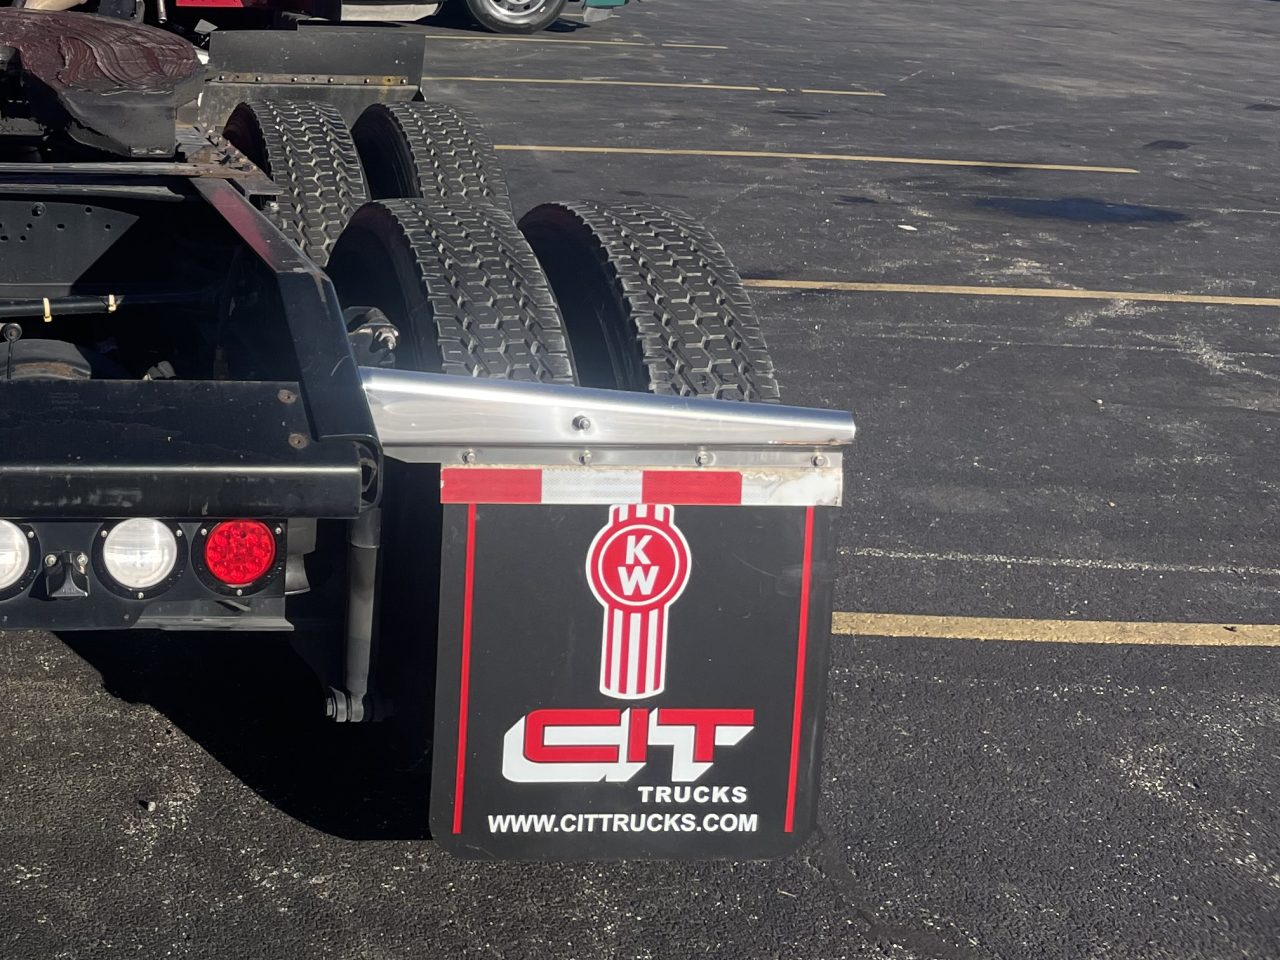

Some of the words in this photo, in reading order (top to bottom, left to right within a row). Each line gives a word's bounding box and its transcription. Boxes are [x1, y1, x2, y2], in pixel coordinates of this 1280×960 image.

[625, 534, 653, 565] K
[617, 565, 659, 596] W
[502, 707, 755, 783] CIT
[638, 786, 748, 803] TRUCKS
[488, 813, 758, 833] WWW.CITTRUCKS.COM
